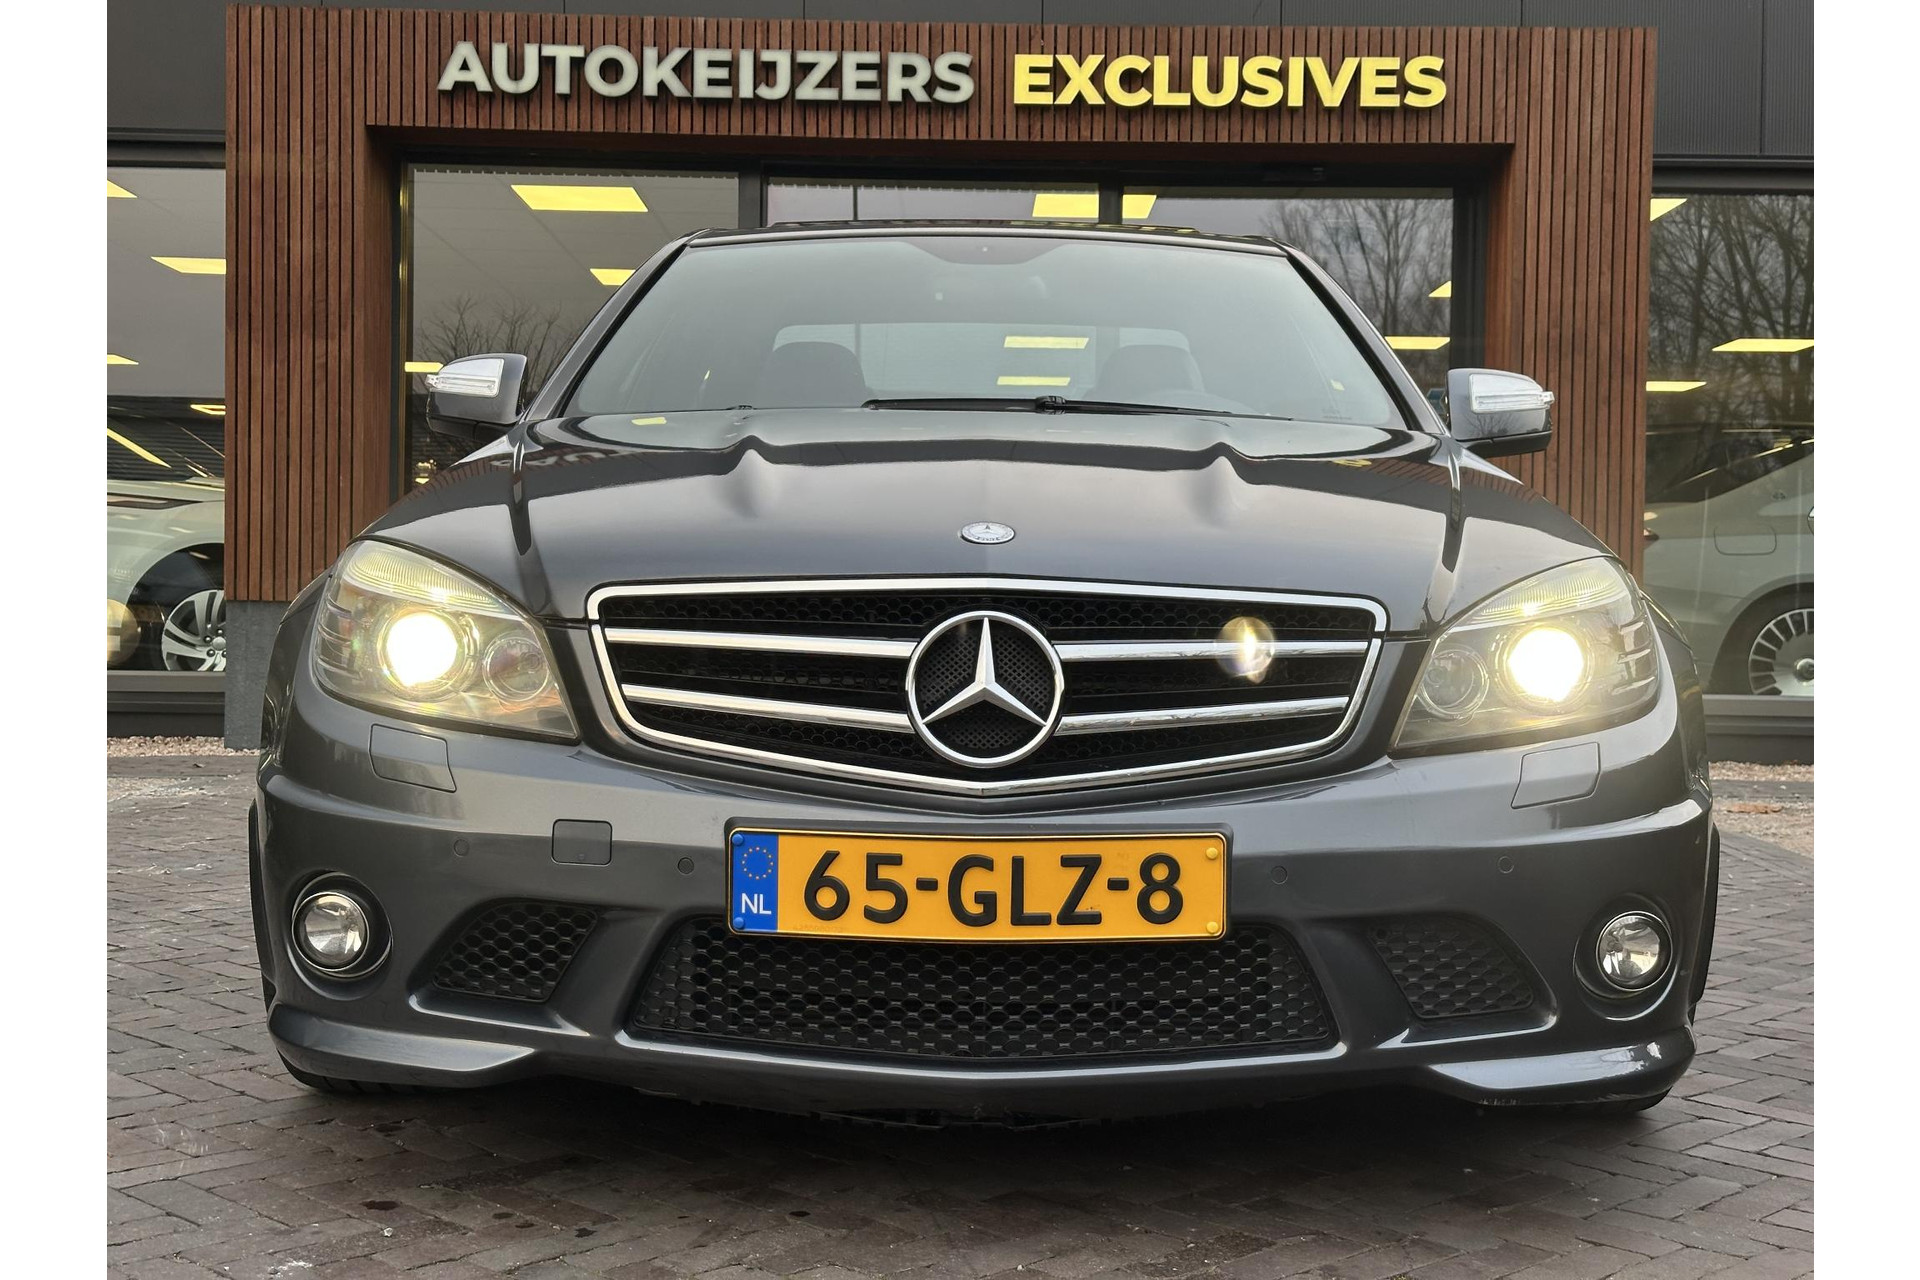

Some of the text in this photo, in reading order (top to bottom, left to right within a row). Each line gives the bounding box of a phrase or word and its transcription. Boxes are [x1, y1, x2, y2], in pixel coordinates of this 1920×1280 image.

[437, 41, 1447, 108] AUTOKEIJZERS EXCLUSIVES
[741, 893, 772, 915] NL
[803, 850, 1184, 927] 65-GLZ-8
